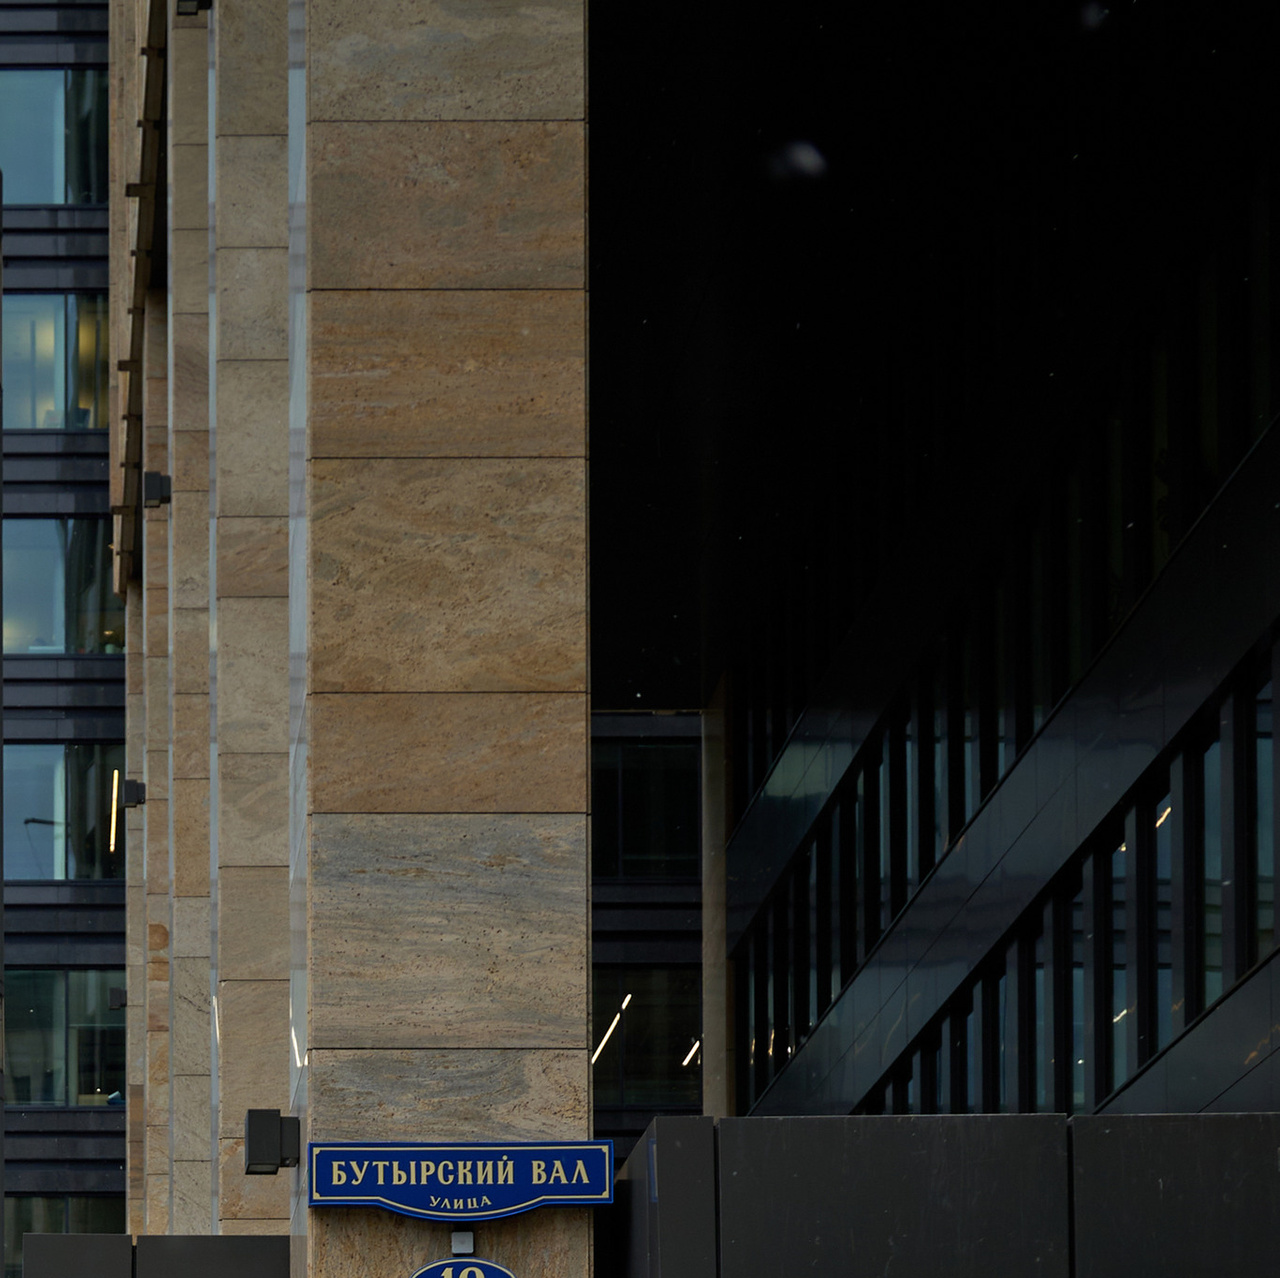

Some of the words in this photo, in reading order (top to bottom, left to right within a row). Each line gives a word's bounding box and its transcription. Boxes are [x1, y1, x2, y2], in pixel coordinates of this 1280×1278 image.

[332, 1154, 514, 1185] БУТЫРСКИЙ
[531, 1159, 590, 1185] ВАЛ
[429, 1195, 492, 1210] УЛИЦА
